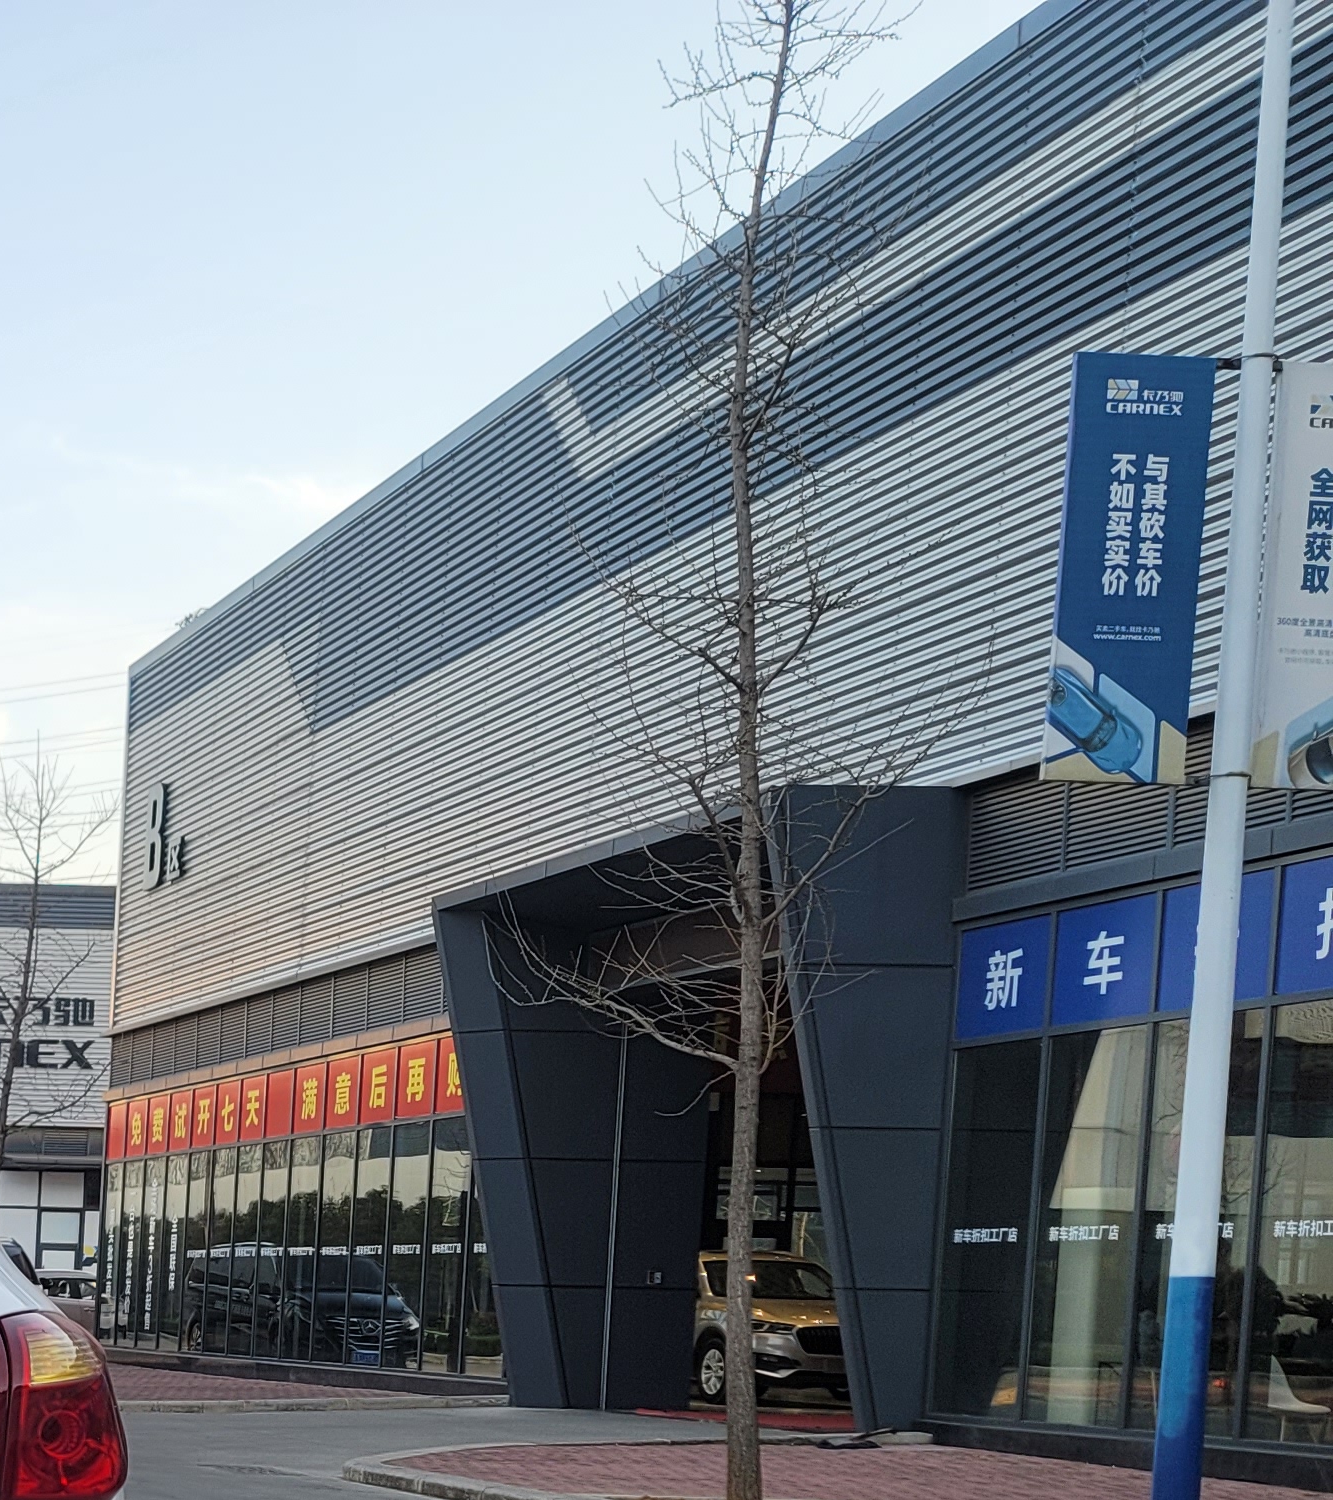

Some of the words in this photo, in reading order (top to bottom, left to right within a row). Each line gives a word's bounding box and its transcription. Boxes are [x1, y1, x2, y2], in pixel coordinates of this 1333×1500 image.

[1142, 389, 1184, 403] 卡乃驰
[1106, 402, 1183, 416] CARNEX
[1101, 453, 1137, 596] 不如买实价
[1134, 453, 1170, 597] 与其砍车价
[1300, 467, 1333, 594] 全网获取
[1093, 633, 1162, 642] www.carnex.com
[131, 1089, 260, 1146] 免费试开七天
[953, 1227, 1018, 1243] 新车折扣工厂店
[1048, 1224, 1120, 1242] 新车折扣工厂店
[1273, 1219, 1333, 1239] 新车折扣工
